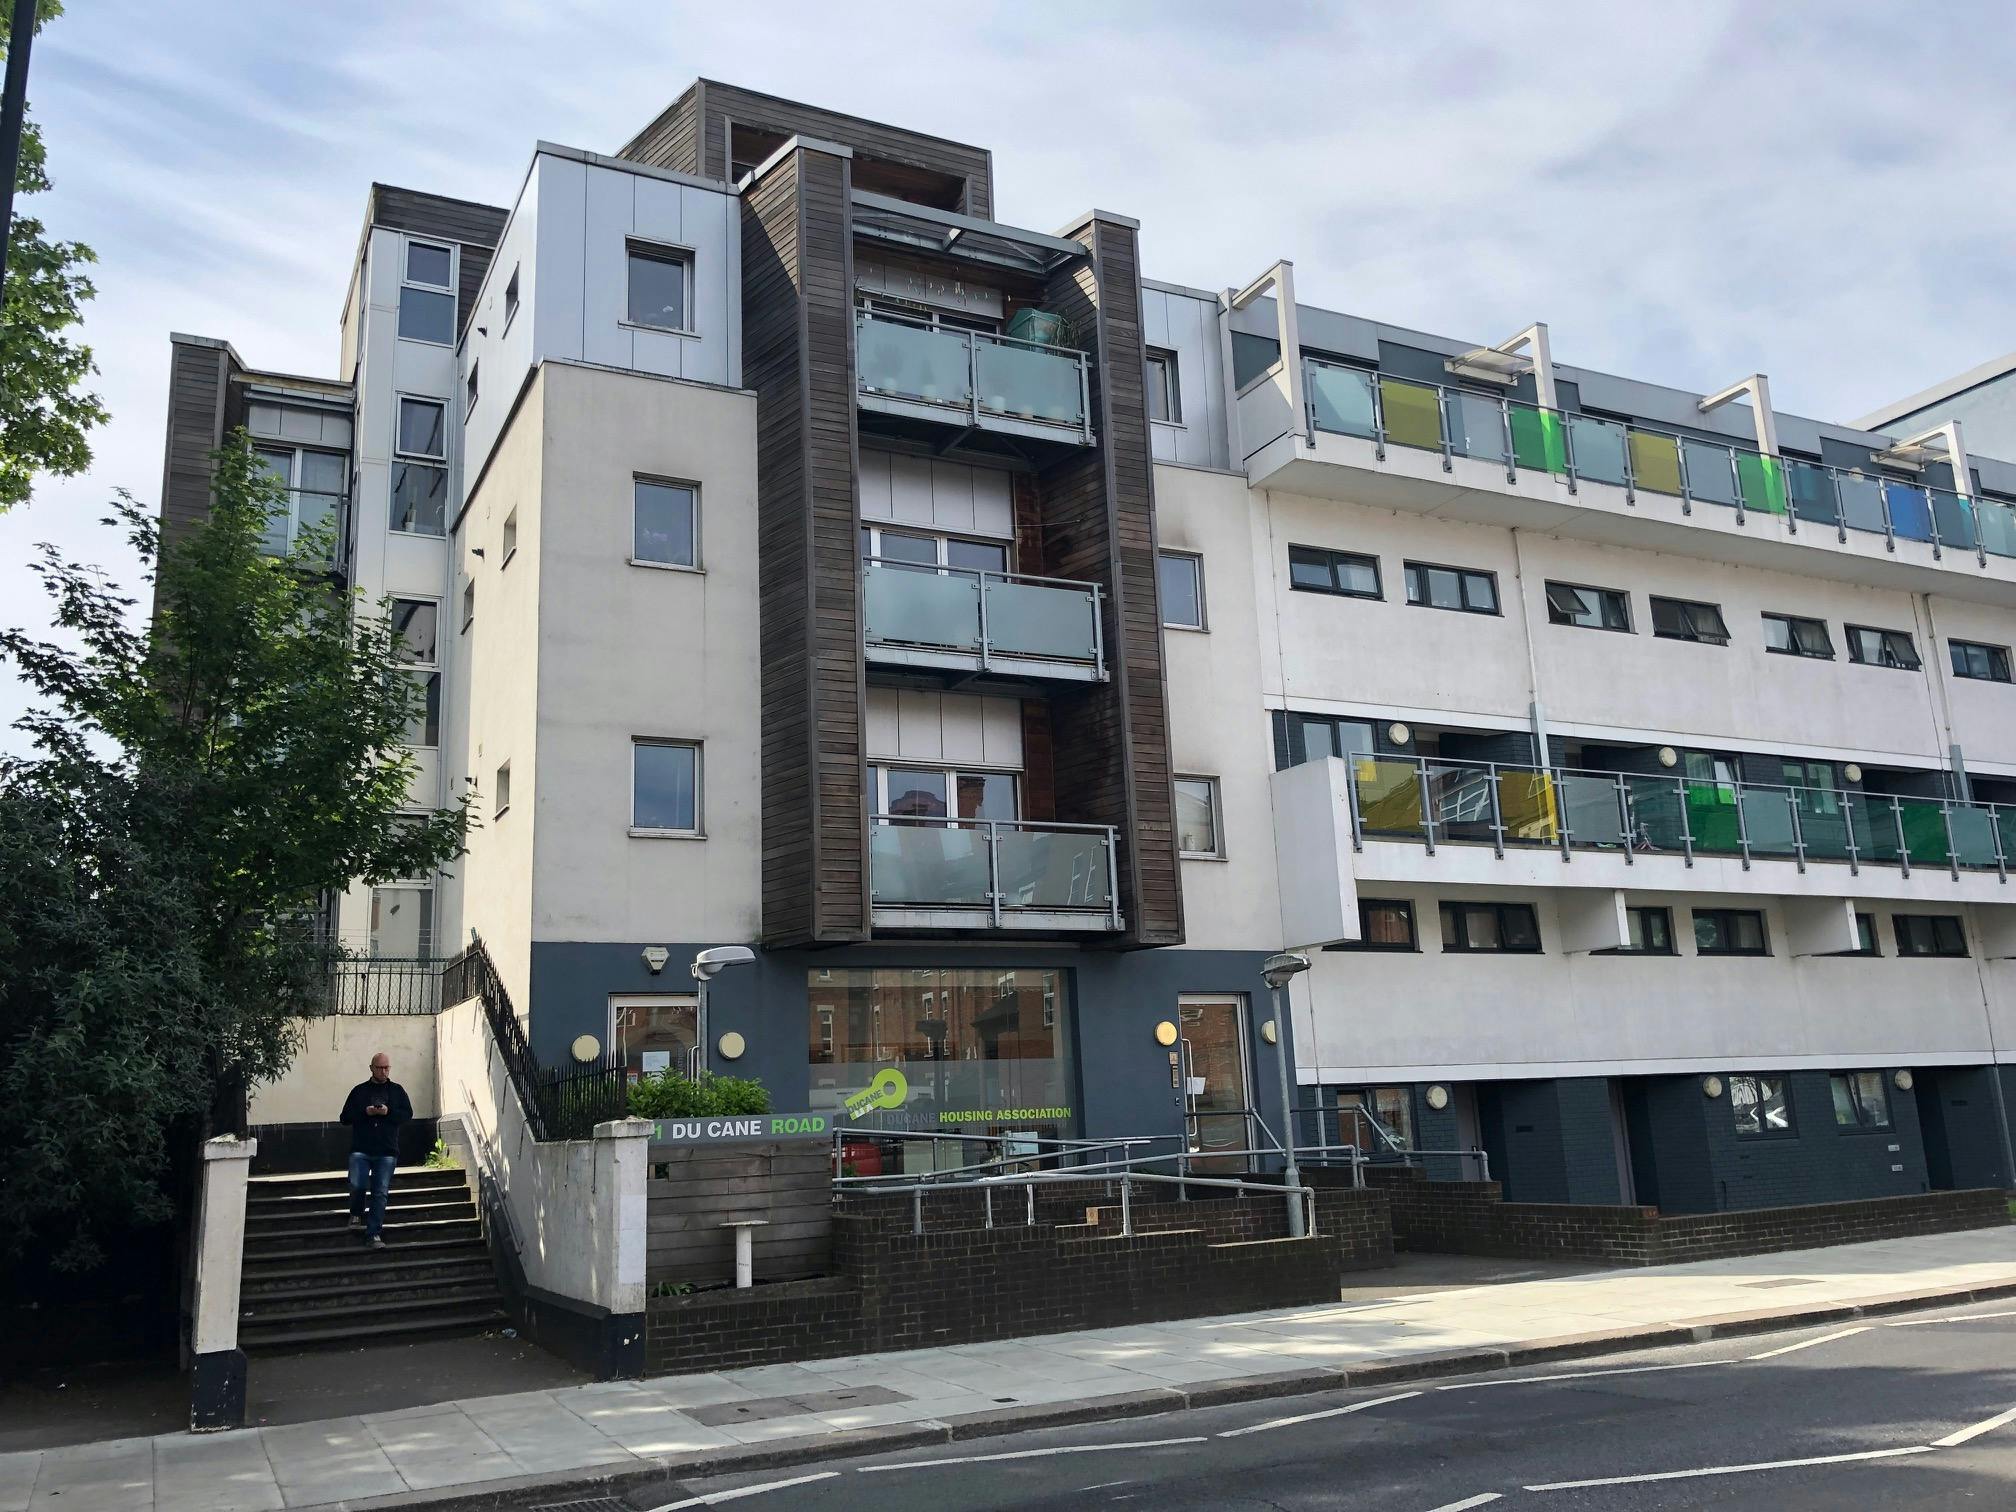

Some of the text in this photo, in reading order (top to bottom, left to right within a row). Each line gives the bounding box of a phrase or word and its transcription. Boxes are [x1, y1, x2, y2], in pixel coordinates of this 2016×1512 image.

[847, 1089, 884, 1113] DUCANE
[887, 1107, 1072, 1125] DUCANE HOUSING ASSOCIATION
[672, 1123, 701, 1139] DU
[707, 1120, 762, 1138] CANE
[771, 1117, 826, 1135] ROAD
